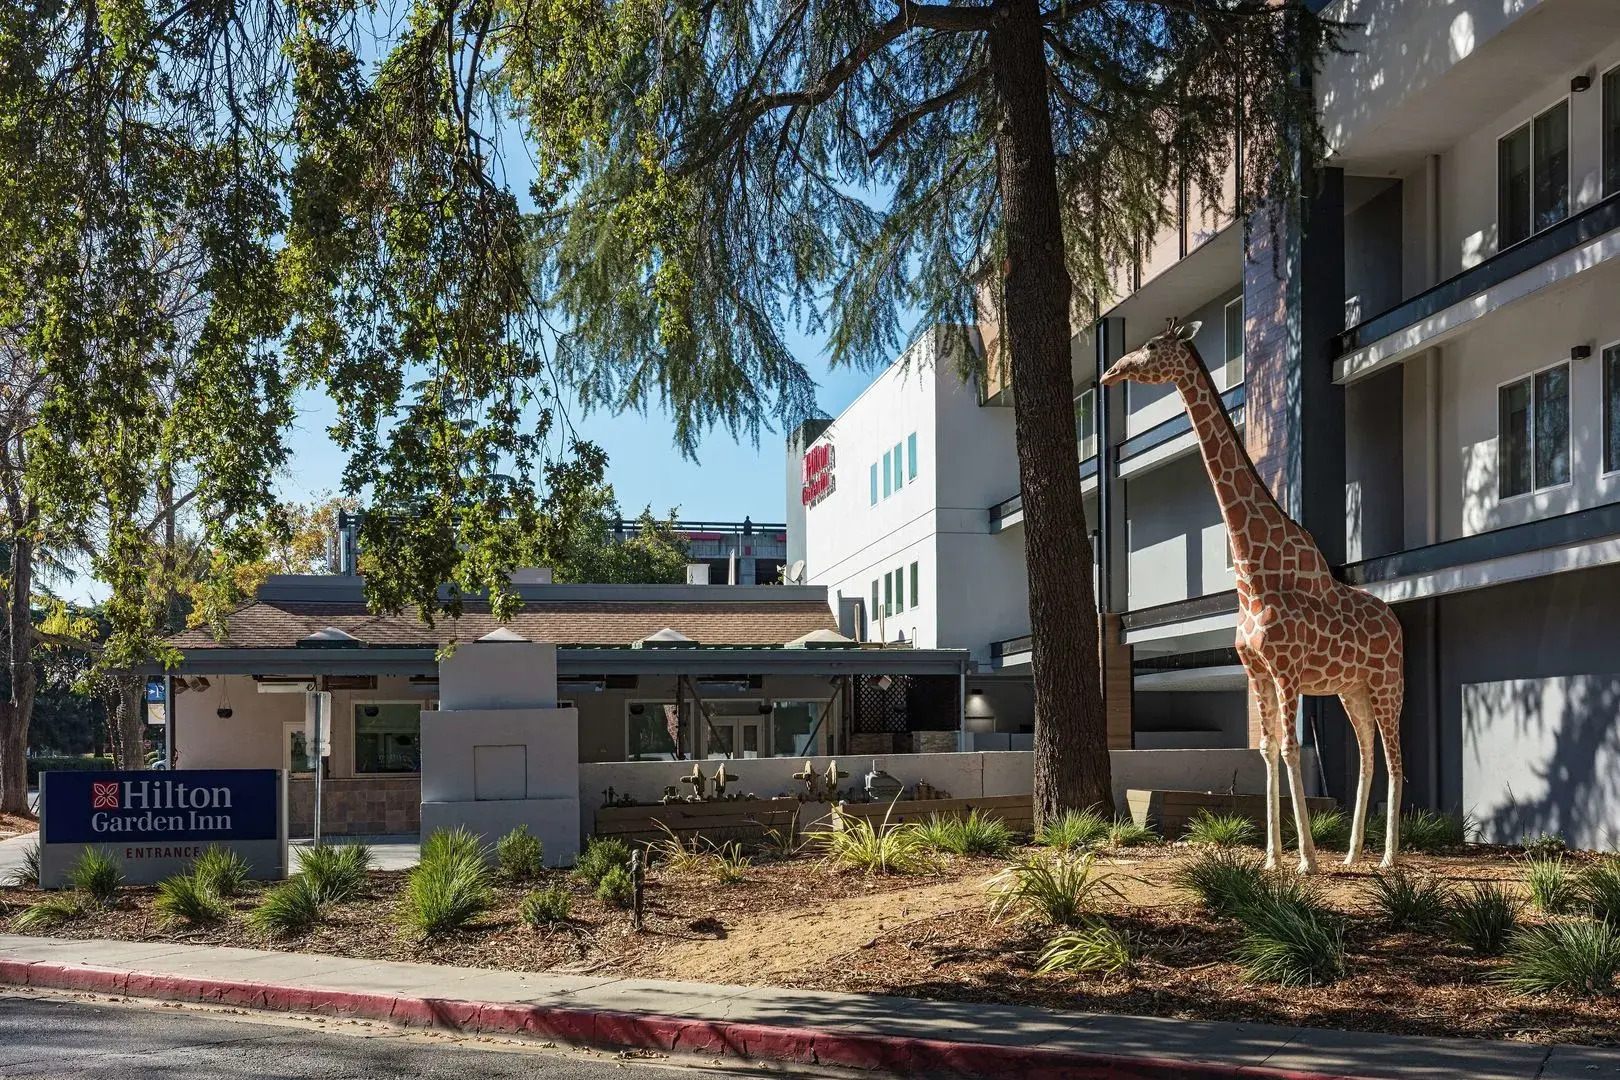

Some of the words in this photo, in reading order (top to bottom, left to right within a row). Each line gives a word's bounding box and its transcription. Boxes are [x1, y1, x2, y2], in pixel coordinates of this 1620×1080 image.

[124, 780, 233, 809] Hilton
[92, 811, 184, 833] Garden
[189, 811, 233, 831] Inn
[126, 846, 200, 859] ENTRANCE
